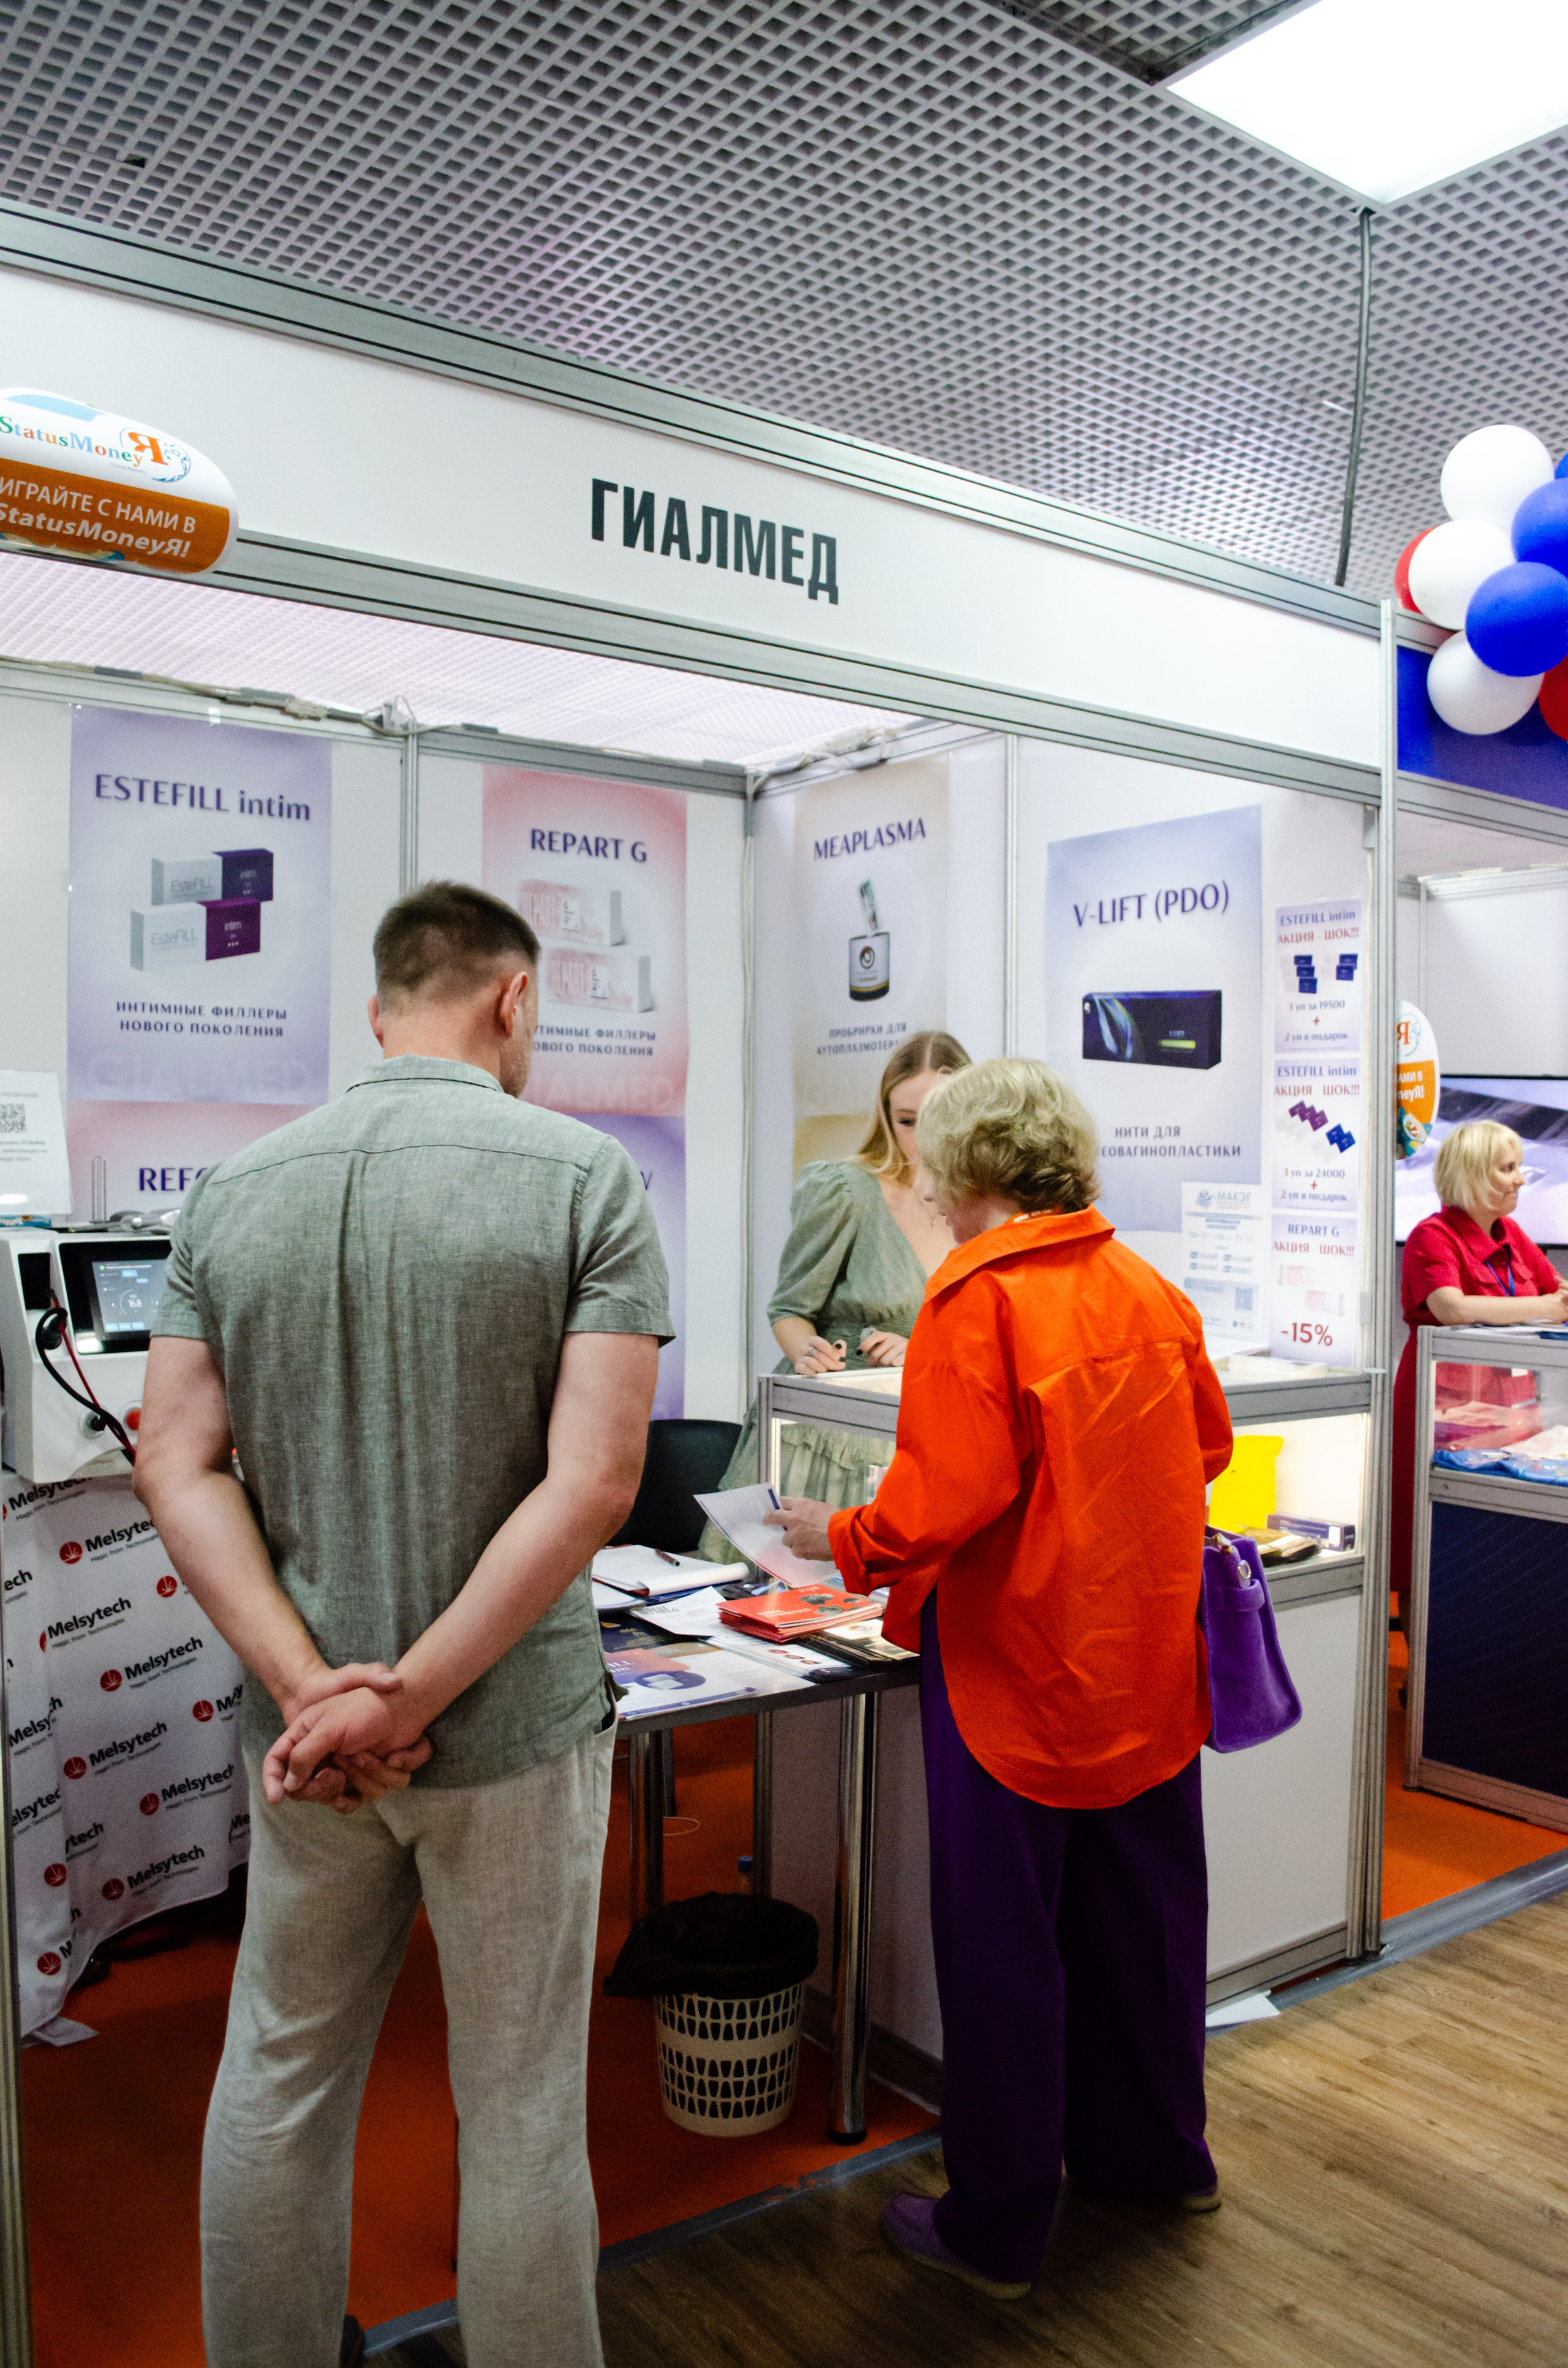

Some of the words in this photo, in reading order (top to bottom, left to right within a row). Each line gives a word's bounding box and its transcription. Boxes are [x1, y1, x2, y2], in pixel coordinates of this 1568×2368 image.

[97, 498, 113, 516] С
[116, 502, 179, 531] НАМИ
[183, 516, 196, 534] В
[592, 478, 839, 605] ГИАЛМЕД
[94, 773, 229, 813] ESTEFILL
[239, 790, 311, 820] intim
[530, 828, 624, 861] REPART
[631, 841, 647, 863] G
[813, 817, 926, 861] MEAPLASMA
[1073, 893, 1147, 928] V-LIFT
[1155, 879, 1229, 922] (PDO)
[1280, 912, 1325, 927] ESTEFILL
[1329, 909, 1355, 922] intim
[1277, 930, 1314, 944] АКЦИЯ
[1324, 927, 1359, 941] ШОК!!!
[116, 1001, 206, 1016] ИНТИМНЫЕ
[211, 1005, 287, 1020] ФИЛЛЕРЫ
[1287, 1002, 1293, 1011] 3
[1319, 999, 1345, 1010] 19500
[120, 1019, 184, 1034] НОВОГО
[190, 1023, 284, 1038] ПОКОЛЕНИЯ
[595, 1028, 656, 1041] ФИЛЛЕРЫ
[886, 1022, 907, 1035] ДЛЯ
[1284, 1032, 1290, 1042] 2
[1311, 1031, 1348, 1043] подарок
[579, 1043, 654, 1056] ПОКОЛЕНИЯ
[1278, 1065, 1324, 1077] ESTEFILL
[1328, 1065, 1356, 1076] intim
[1274, 1084, 1312, 1097] АКЦИЯ
[1323, 1084, 1360, 1096] ШОК!!!
[1115, 1126, 1149, 1138] НИТИ
[1153, 1125, 1180, 1139] ДЛЯ
[1283, 1167, 1288, 1177] 3
[1316, 1168, 1345, 1178] 24000
[1281, 1190, 1286, 1199] 2
[1308, 1192, 1348, 1203] подарок
[1288, 1223, 1328, 1236] REPART
[1332, 1226, 1340, 1237] G
[1272, 1241, 1310, 1253] АКЦИЯ
[1319, 1244, 1355, 1257] ШОК!!!
[1281, 1322, 1333, 1347] -15%
[9, 1477, 92, 1511] Melsyte
[48, 1597, 132, 1639] Melsytech
[124, 1636, 203, 1680] Melsytech
[89, 1722, 168, 1767] Melsytech
[127, 1844, 205, 1889] Melsytech
